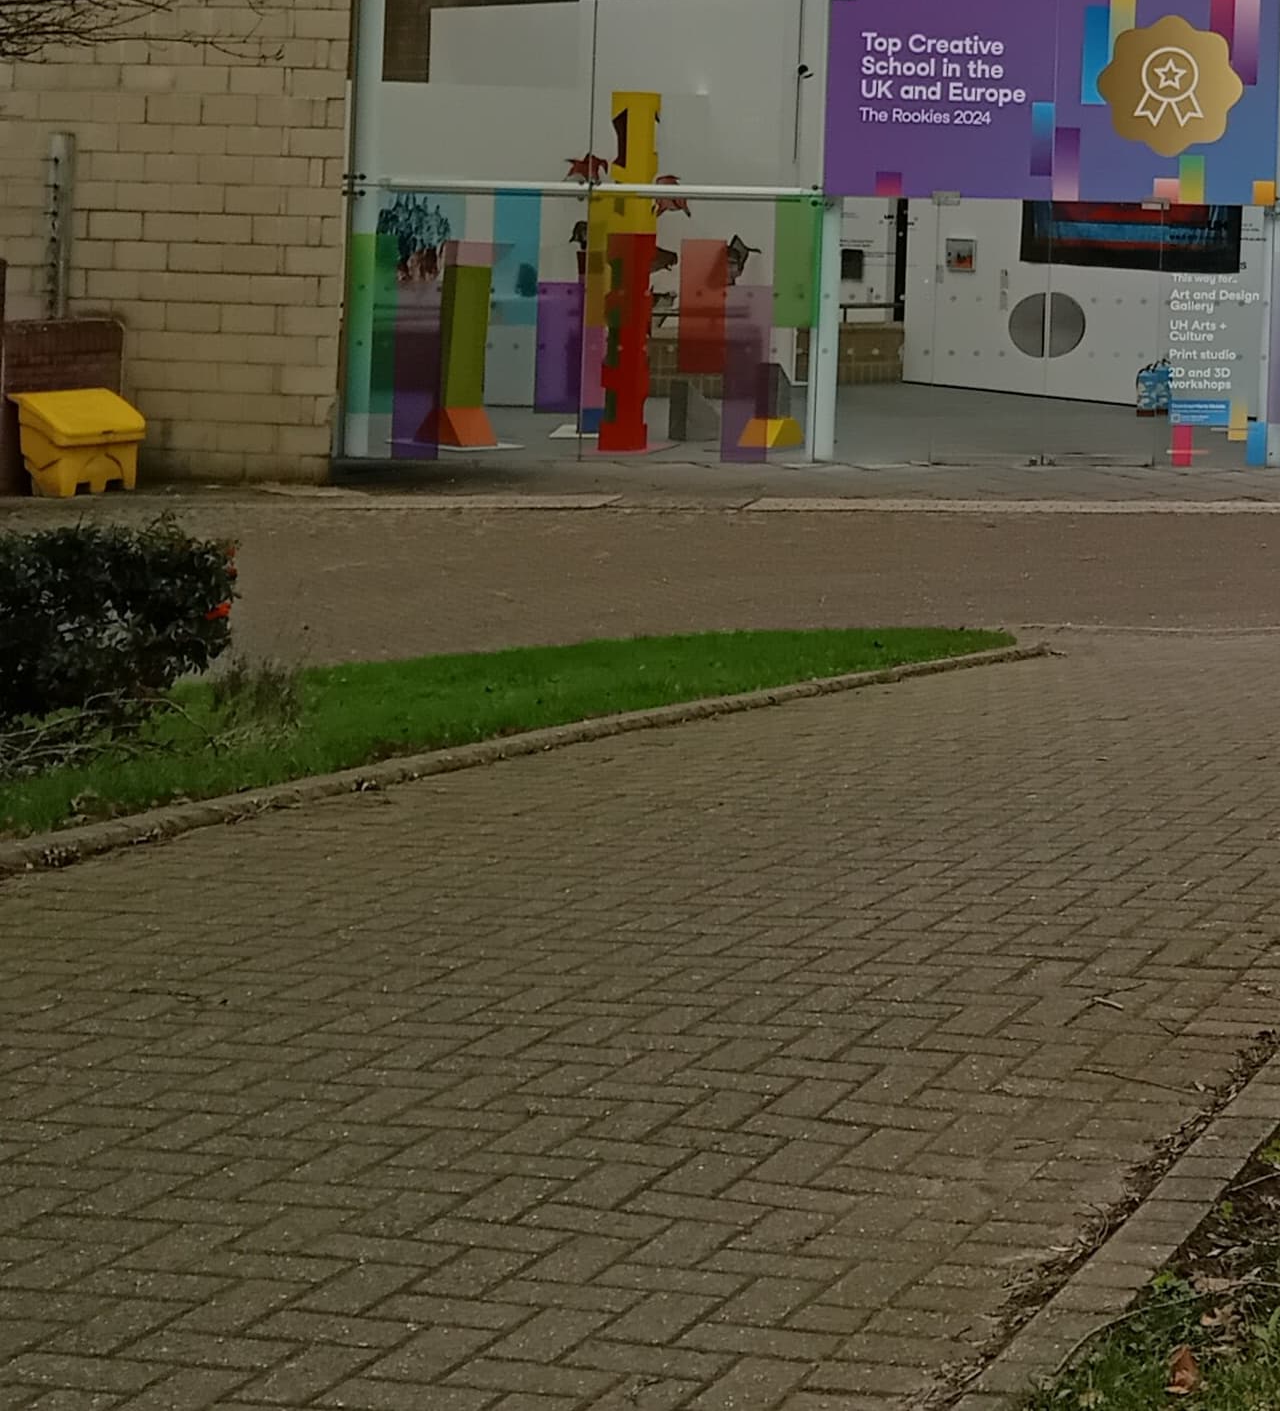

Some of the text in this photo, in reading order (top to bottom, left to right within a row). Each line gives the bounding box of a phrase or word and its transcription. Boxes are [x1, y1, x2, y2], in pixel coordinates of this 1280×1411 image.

[862, 32, 1004, 56] Top Creative
[861, 56, 1004, 78] School in the
[861, 79, 1026, 107] UK and Europe
[859, 107, 991, 125] The Rookies 2024
[1173, 274, 1192, 283] This
[1193, 275, 1216, 285] way
[1170, 289, 1260, 304] Art and Design
[1170, 301, 1214, 314] Gallery
[1170, 320, 1188, 330] UH
[1191, 320, 1216, 331] Arts
[1169, 331, 1214, 341] Culture
[1169, 348, 1236, 360] Print studio
[1168, 367, 1231, 378] 2D and 3D
[1168, 379, 1232, 392] workshops
